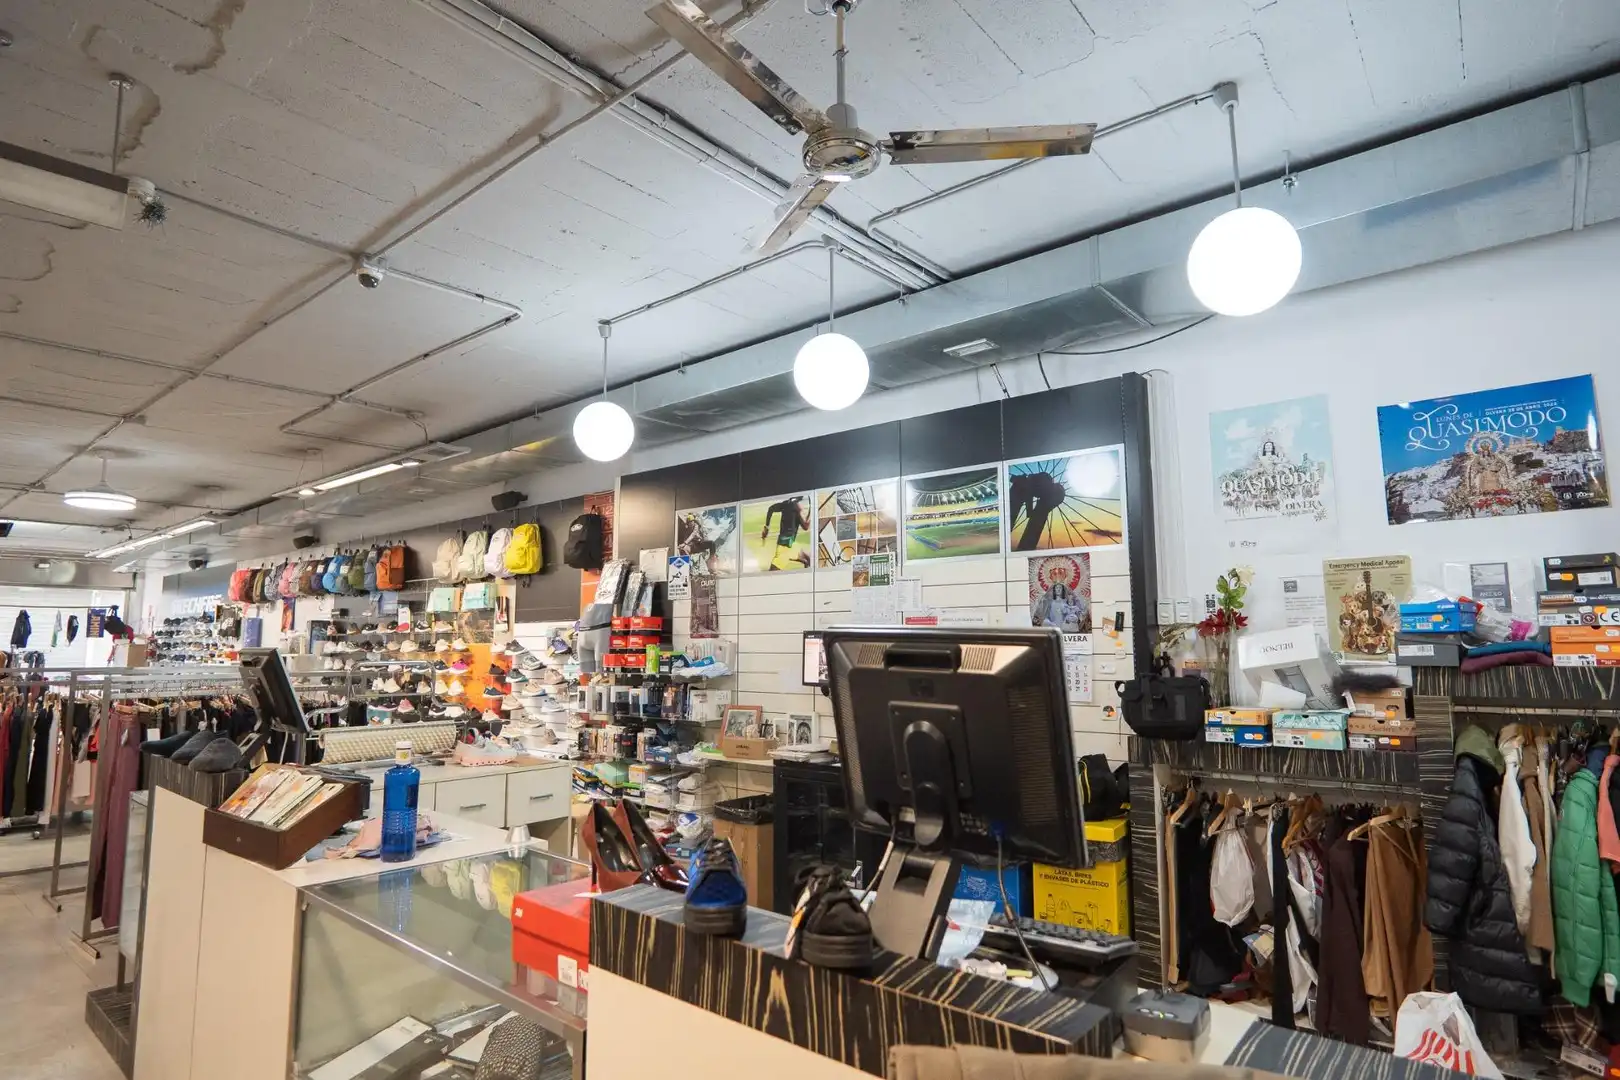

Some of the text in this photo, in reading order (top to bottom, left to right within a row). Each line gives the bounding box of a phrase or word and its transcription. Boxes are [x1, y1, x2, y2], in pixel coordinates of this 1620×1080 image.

[1436, 414, 1461, 423] LUNES
[1405, 404, 1567, 451] QUASIMODO
[1054, 869, 1073, 878] LATAS,
[1044, 874, 1069, 883] ENVASES
